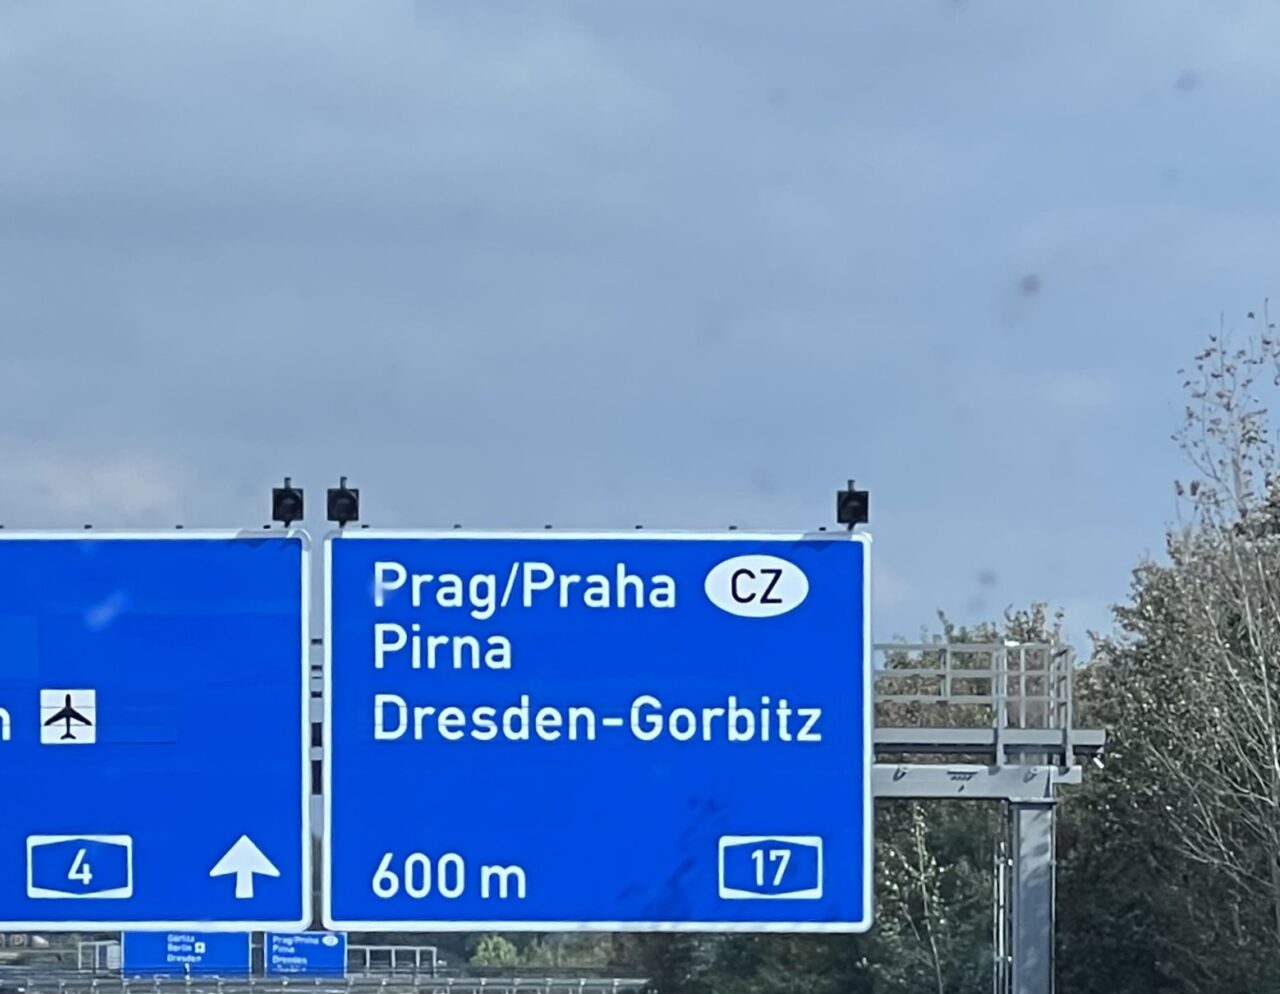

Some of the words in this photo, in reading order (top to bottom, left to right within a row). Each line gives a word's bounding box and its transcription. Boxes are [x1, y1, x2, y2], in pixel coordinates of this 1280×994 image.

[374, 561, 676, 620] Prag/Praha
[731, 568, 783, 604] CZ
[374, 623, 511, 669] Pirna
[374, 694, 822, 742] Dresden-Gorbitz
[67, 848, 93, 886] 4
[372, 852, 465, 899] 600
[481, 865, 526, 899] m
[751, 849, 791, 886] 17
